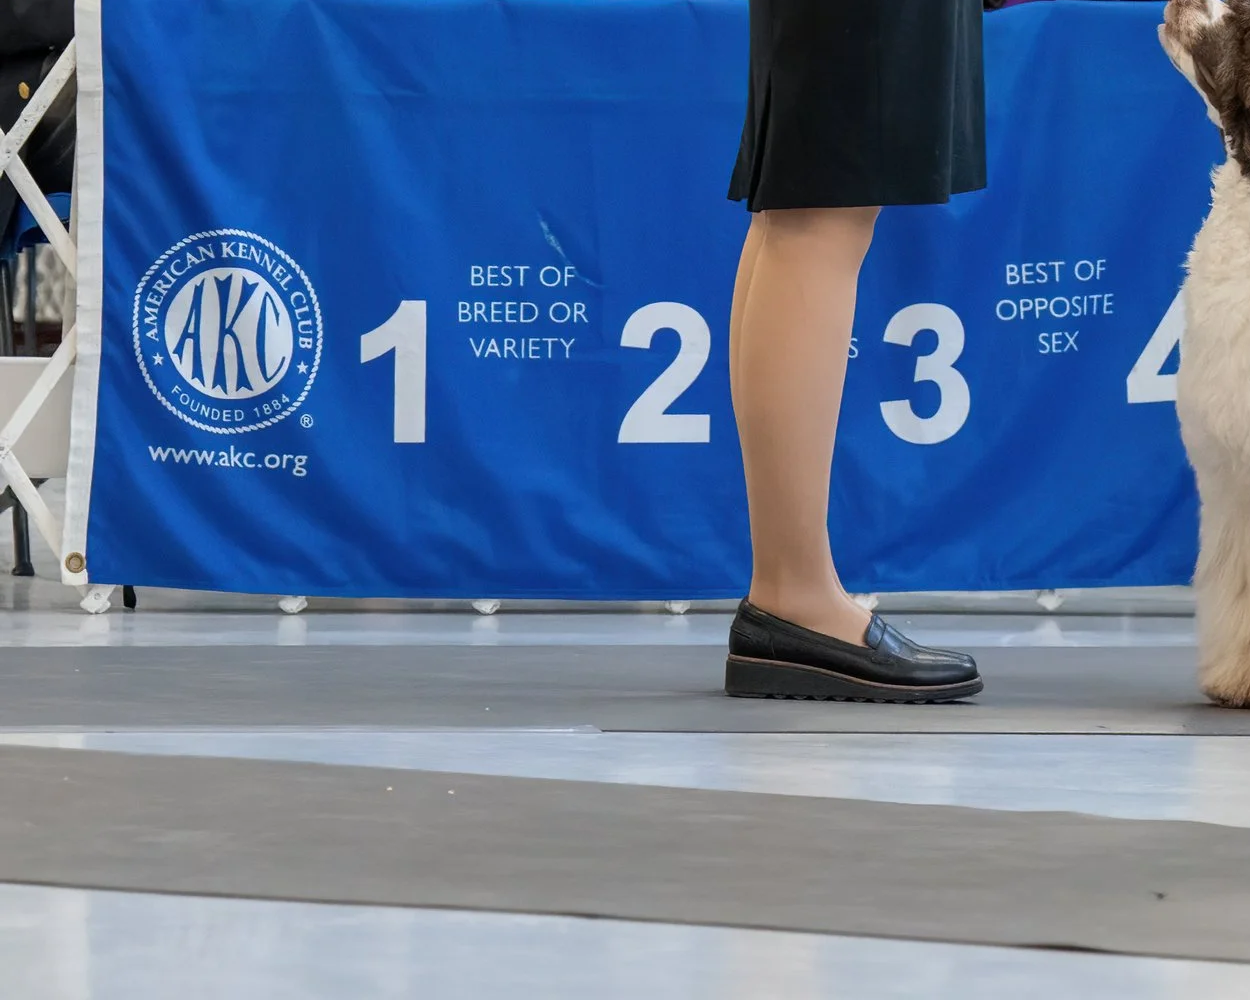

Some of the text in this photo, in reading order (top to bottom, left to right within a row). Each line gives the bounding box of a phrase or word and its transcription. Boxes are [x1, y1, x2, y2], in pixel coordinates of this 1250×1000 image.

[470, 265, 575, 287] BEST OF
[1006, 259, 1107, 285] BEST OF
[144, 241, 313, 350] AMERICAN KENNEL CLUB
[458, 301, 588, 323] BREED OR
[996, 294, 1113, 321] OPPOSITE
[172, 273, 286, 396] AKC
[469, 337, 575, 359] VARIETY
[1038, 331, 1079, 354] SEX
[360, 299, 427, 444] 1
[617, 301, 711, 444] 2
[879, 302, 971, 445] 3
[171, 384, 291, 422] FOUNDED 1884
[148, 445, 309, 478] www.akc.org
